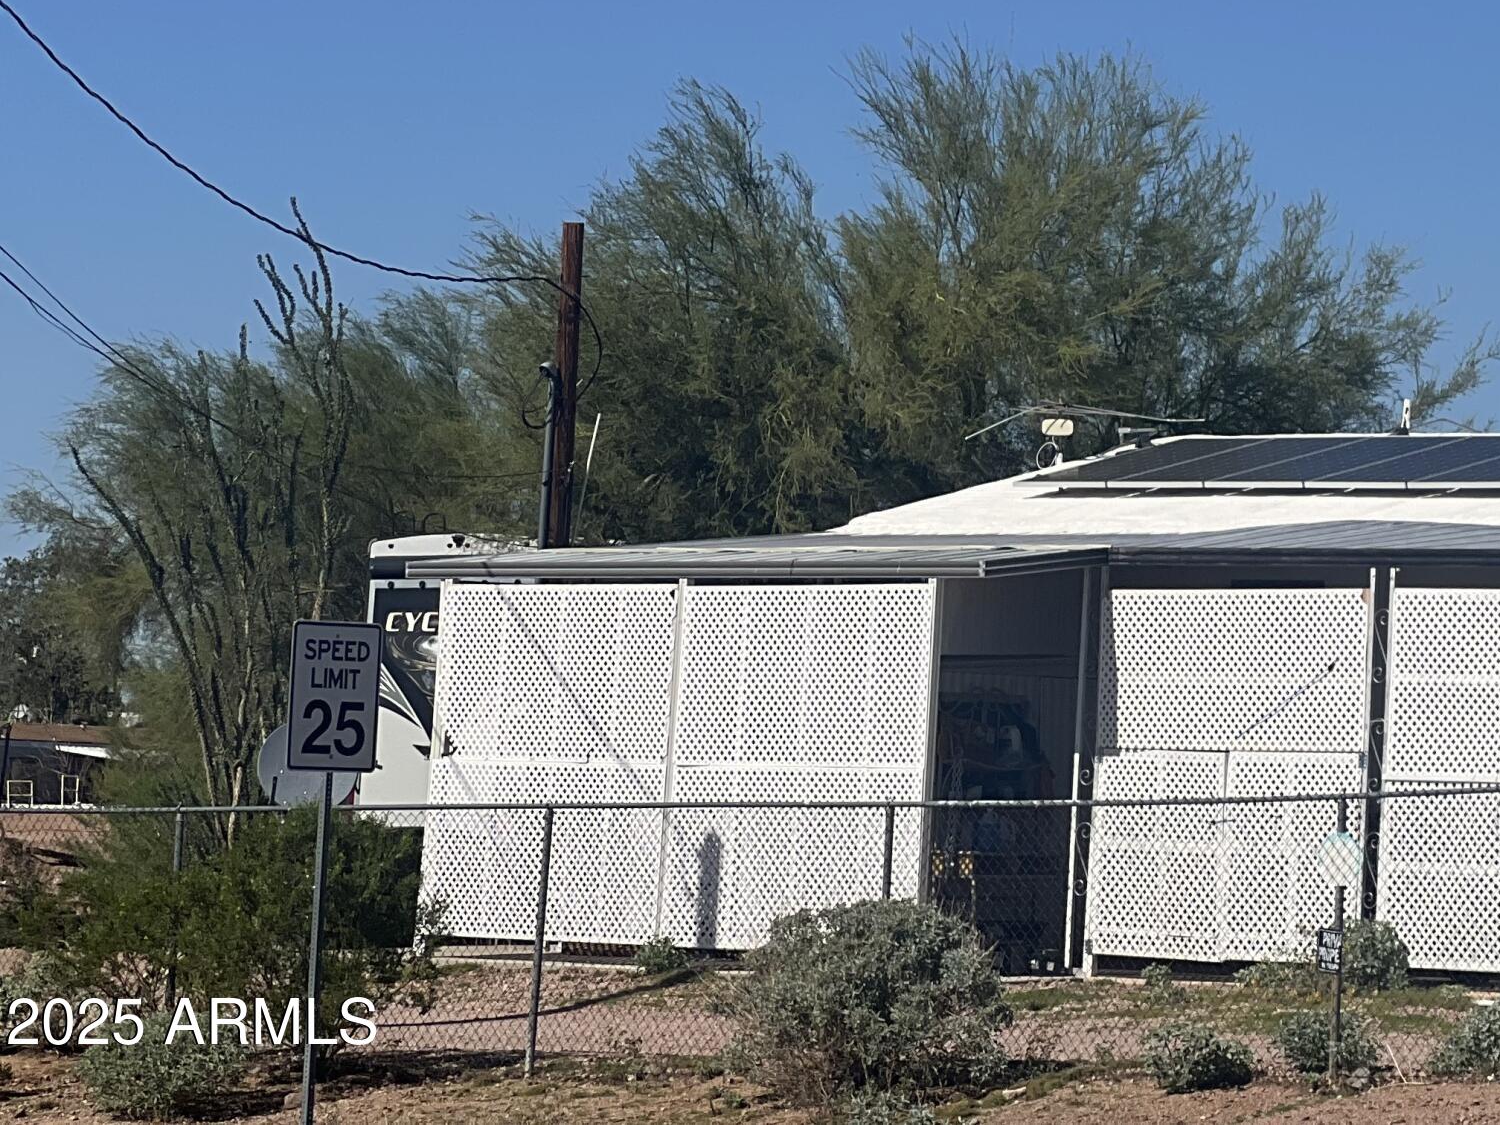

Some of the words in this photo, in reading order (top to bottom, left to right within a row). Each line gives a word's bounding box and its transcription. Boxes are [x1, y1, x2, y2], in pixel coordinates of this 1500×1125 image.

[304, 638, 371, 663] SPEED
[310, 668, 361, 690] LIMIT
[301, 699, 366, 757] 25
